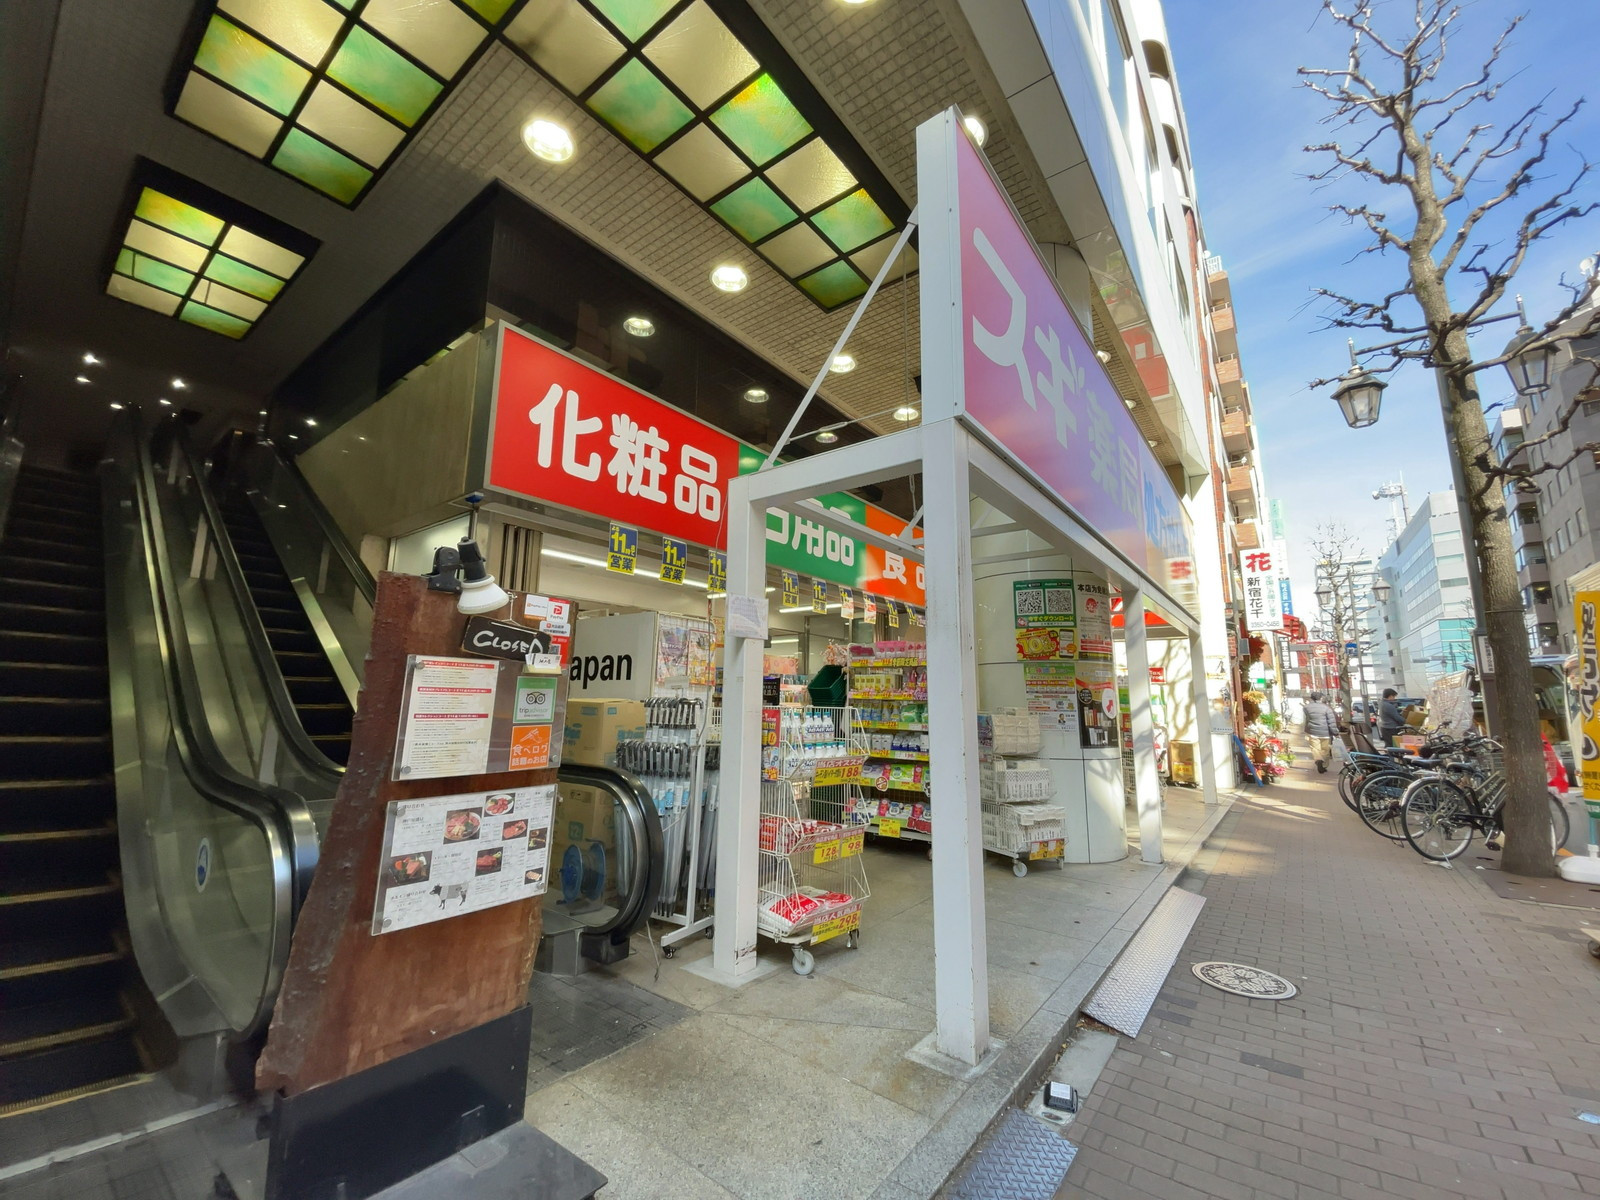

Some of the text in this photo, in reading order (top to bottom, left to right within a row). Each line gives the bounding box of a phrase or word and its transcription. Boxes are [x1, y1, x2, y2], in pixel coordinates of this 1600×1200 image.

[529, 383, 721, 522] 化粧品
[610, 554, 633, 571] 営業
[1245, 552, 1272, 573] 花
[663, 566, 682, 582] 営業
[1247, 576, 1263, 619] 新宿花千
[473, 630, 543, 654] CLOSED
[570, 655, 632, 689] apan
[512, 743, 549, 756] 食べログ
[841, 766, 859, 778] 188
[821, 846, 837, 857] 128
[848, 840, 861, 850] 98
[839, 913, 858, 929] 298
